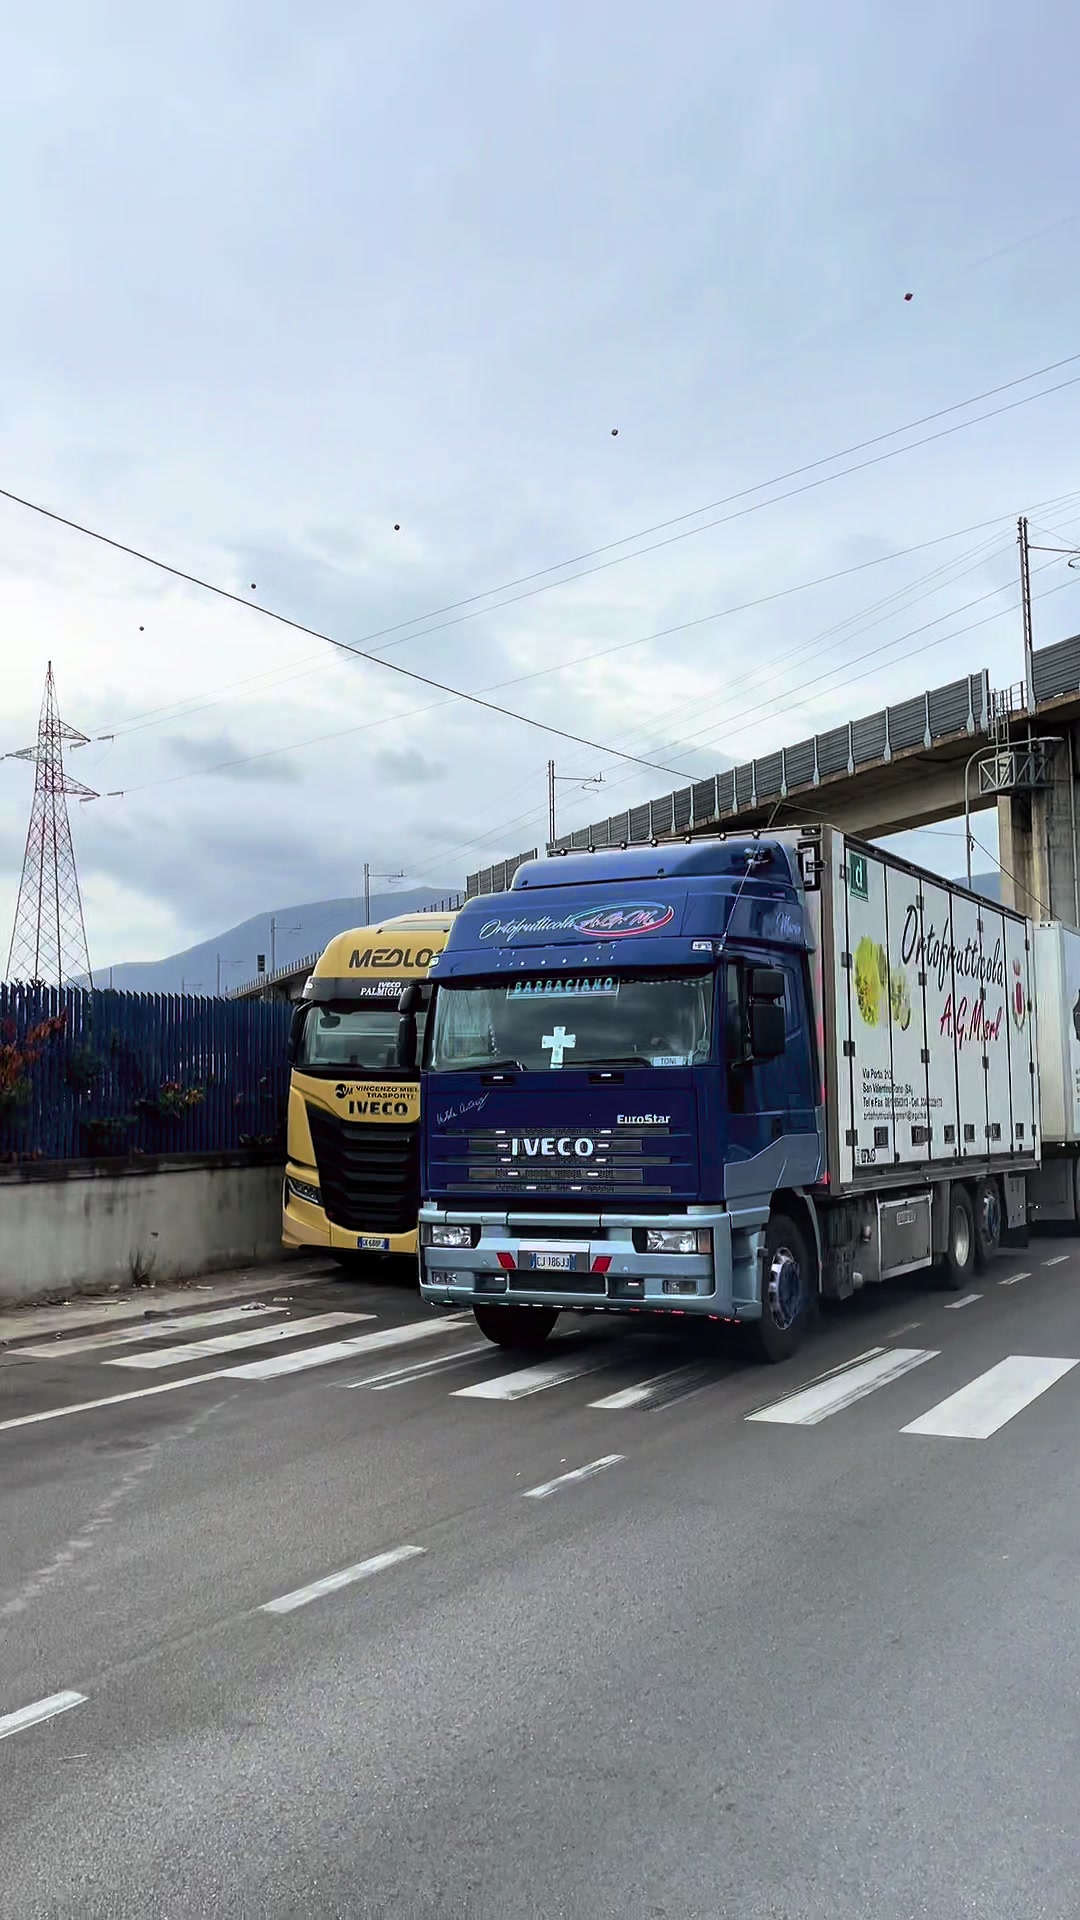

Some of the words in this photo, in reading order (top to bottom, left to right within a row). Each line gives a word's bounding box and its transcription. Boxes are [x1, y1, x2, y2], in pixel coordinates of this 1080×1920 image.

[479, 914, 576, 942] Ortofrutticola
[902, 905, 1004, 992] Ortofrutticola
[348, 948, 444, 969] MEDLO
[355, 1085, 398, 1093] VINCENZO
[862, 1081, 873, 1093] San
[348, 1100, 409, 1116] IVECO
[616, 1114, 671, 1125] EuroStar
[511, 1137, 594, 1157] IVECO
